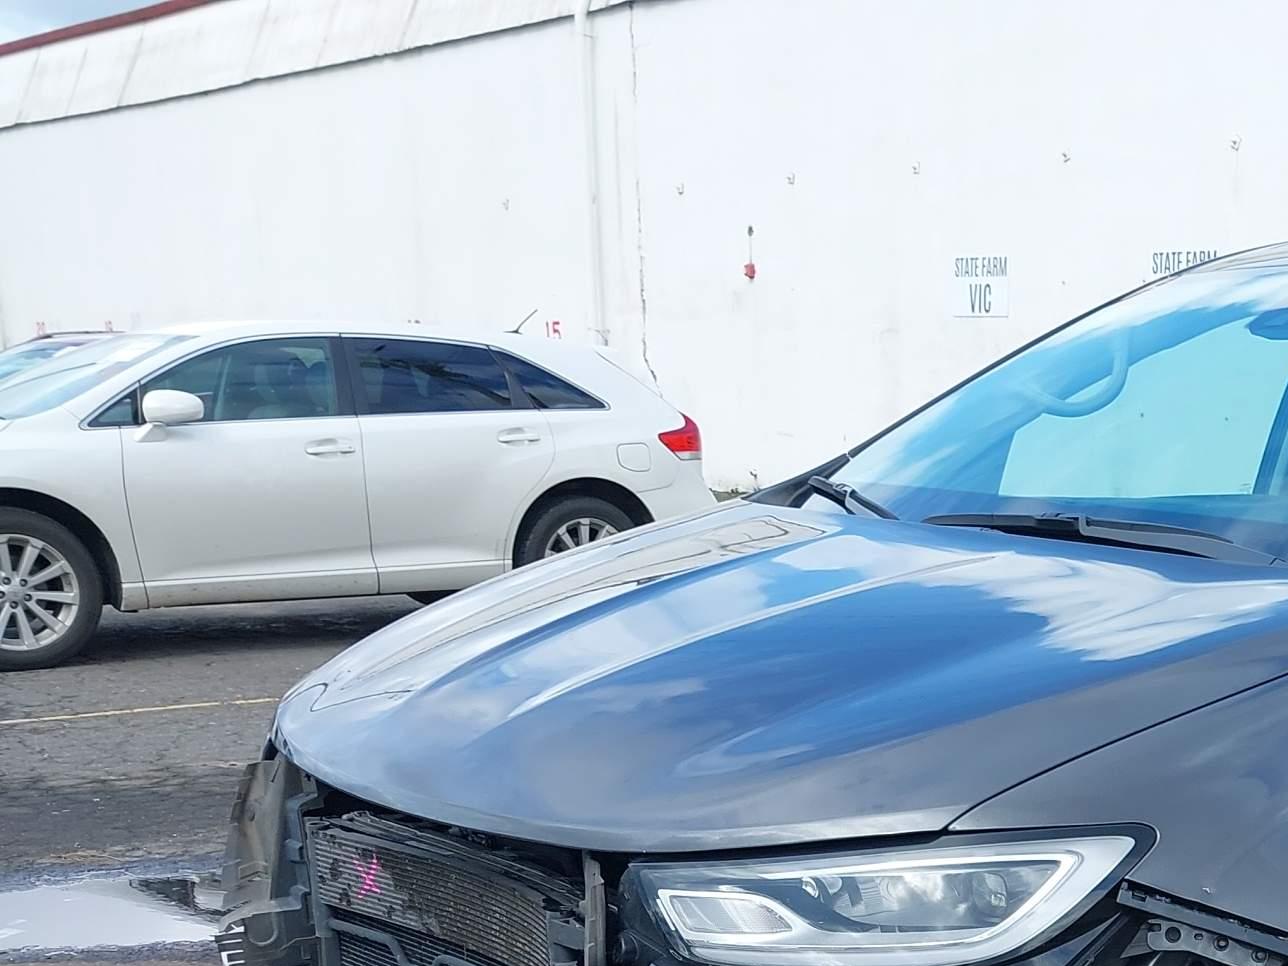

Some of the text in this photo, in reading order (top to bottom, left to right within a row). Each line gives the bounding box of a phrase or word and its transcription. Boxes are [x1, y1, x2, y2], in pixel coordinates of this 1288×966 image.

[954, 256, 1008, 278] STATE FARM
[1152, 251, 1183, 275] STATE
[969, 283, 992, 313] VIC
[545, 320, 562, 340] 15
